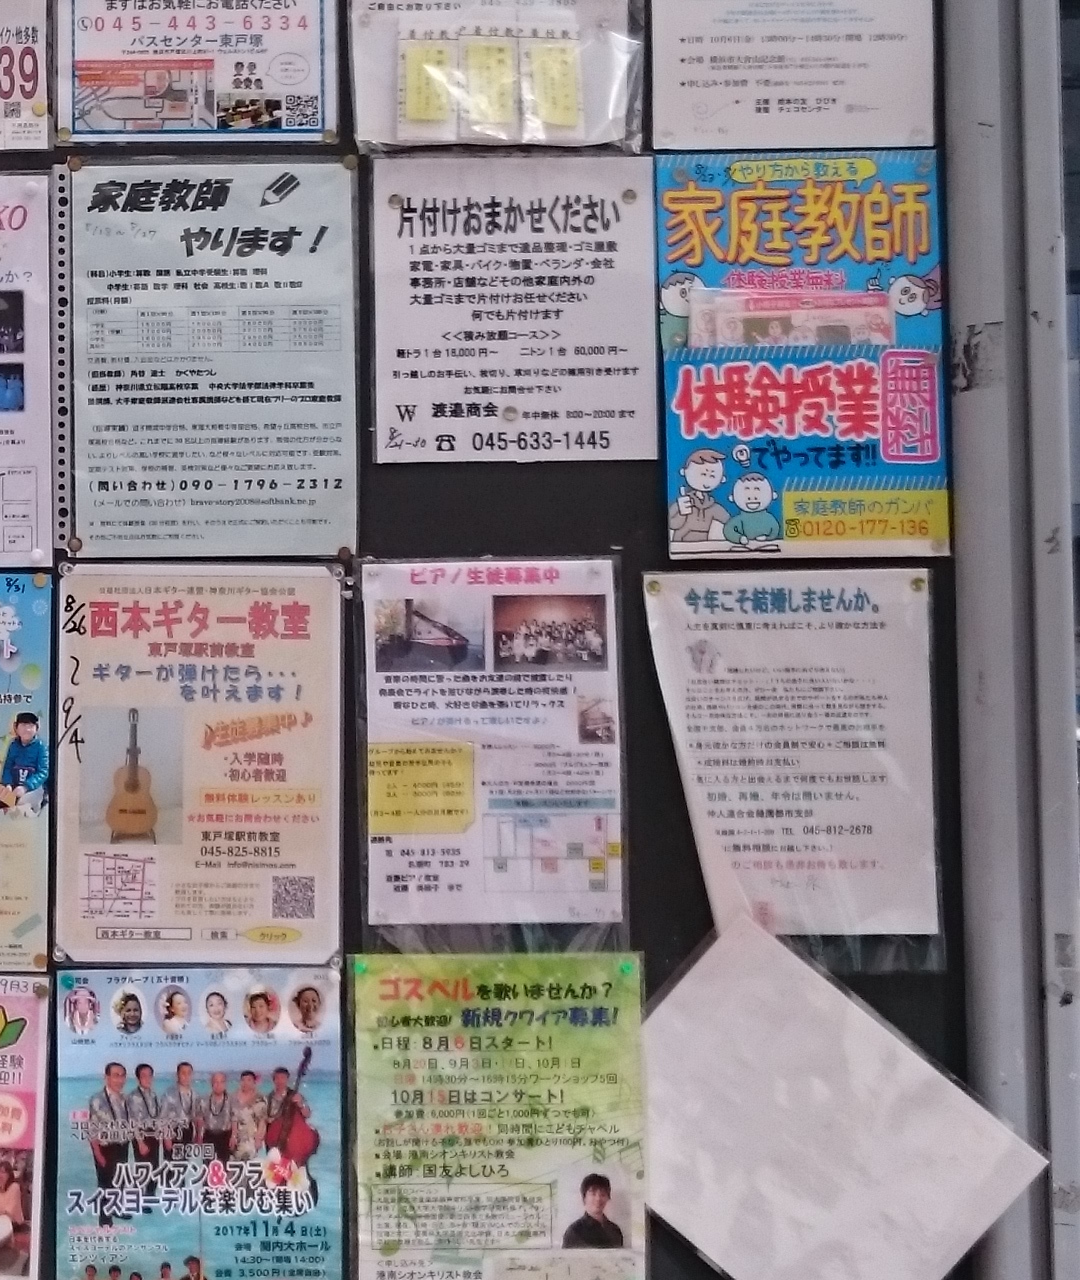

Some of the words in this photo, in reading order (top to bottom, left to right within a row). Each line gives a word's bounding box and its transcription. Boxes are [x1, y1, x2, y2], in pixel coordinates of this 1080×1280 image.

[94, 16, 309, 32] 045-443-6334
[737, 163, 860, 179] やり方から教える
[87, 177, 234, 213] 家庭教師
[398, 194, 620, 238] 片付けおまかせください
[661, 179, 932, 267] 家庭教師
[179, 225, 329, 257] やります！
[409, 275, 595, 288] 事務所・店舗などその他家庭内外の
[409, 292, 587, 306] 大量ゴミまで片付けお任せください
[471, 309, 564, 321] 何でも片付けます
[672, 362, 881, 439] 体験授業
[887, 357, 932, 457] 無料
[472, 431, 611, 451] 045-633-1445
[793, 498, 935, 516] 家庭教師のガンバ
[802, 519, 929, 537] 0120-177-136
[409, 567, 561, 586] ピアノ生徒募集中
[684, 586, 880, 615] 今年こそ結婚しませんか。
[88, 600, 311, 641] 西本ギター教室
[147, 642, 256, 658] 東戸塚駅前教室
[179, 684, 303, 703] を叶えます！
[204, 792, 317, 805] 無料体験レッスンあり
[201, 830, 281, 843] 東戸塚駅前教室
[803, 825, 873, 836] 045-812-2678
[200, 845, 281, 858] 045-825-8815
[100, 929, 162, 940] 西本ギター教室
[258, 931, 288, 941] クリック
[378, 976, 614, 1002] ゴスペルを歌いませんか？
[172, 1143, 215, 1159] 第20回
[113, 1160, 264, 1189] ハワイアン&フラ
[66, 1188, 316, 1216] スイスヨーデルを楽しむ集い
[259, 1241, 331, 1254] 関内大ホール
[376, 1268, 483, 1280] 港南シオンキリスト教会
